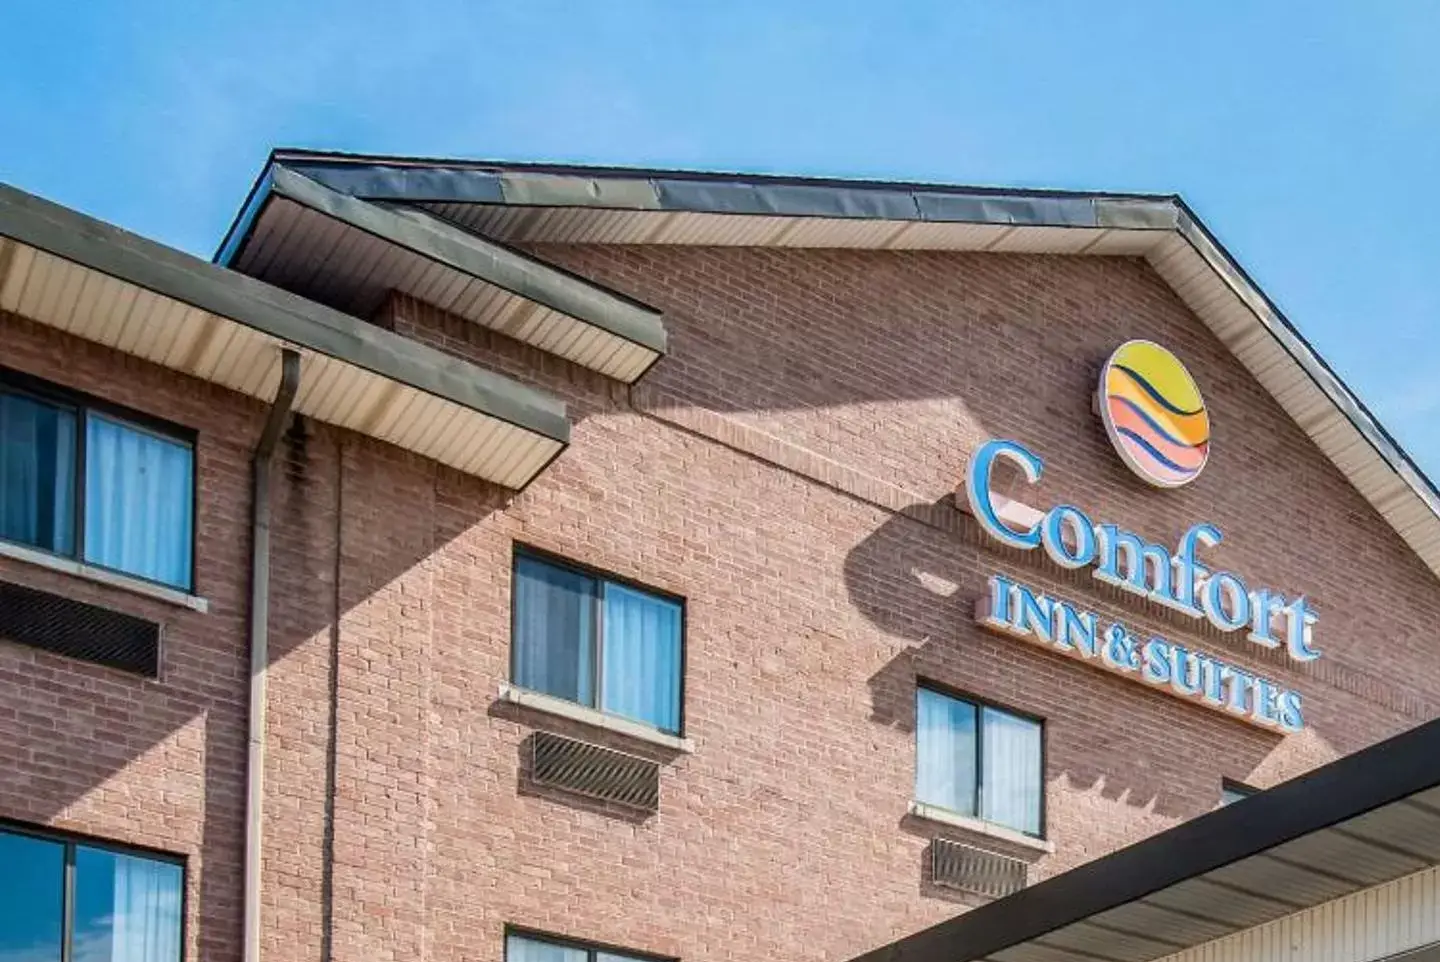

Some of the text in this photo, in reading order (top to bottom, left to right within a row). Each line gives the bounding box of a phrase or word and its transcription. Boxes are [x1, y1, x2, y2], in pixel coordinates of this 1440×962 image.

[966, 439, 1320, 661] Comfort
[988, 574, 1305, 732] INN & SUITES
